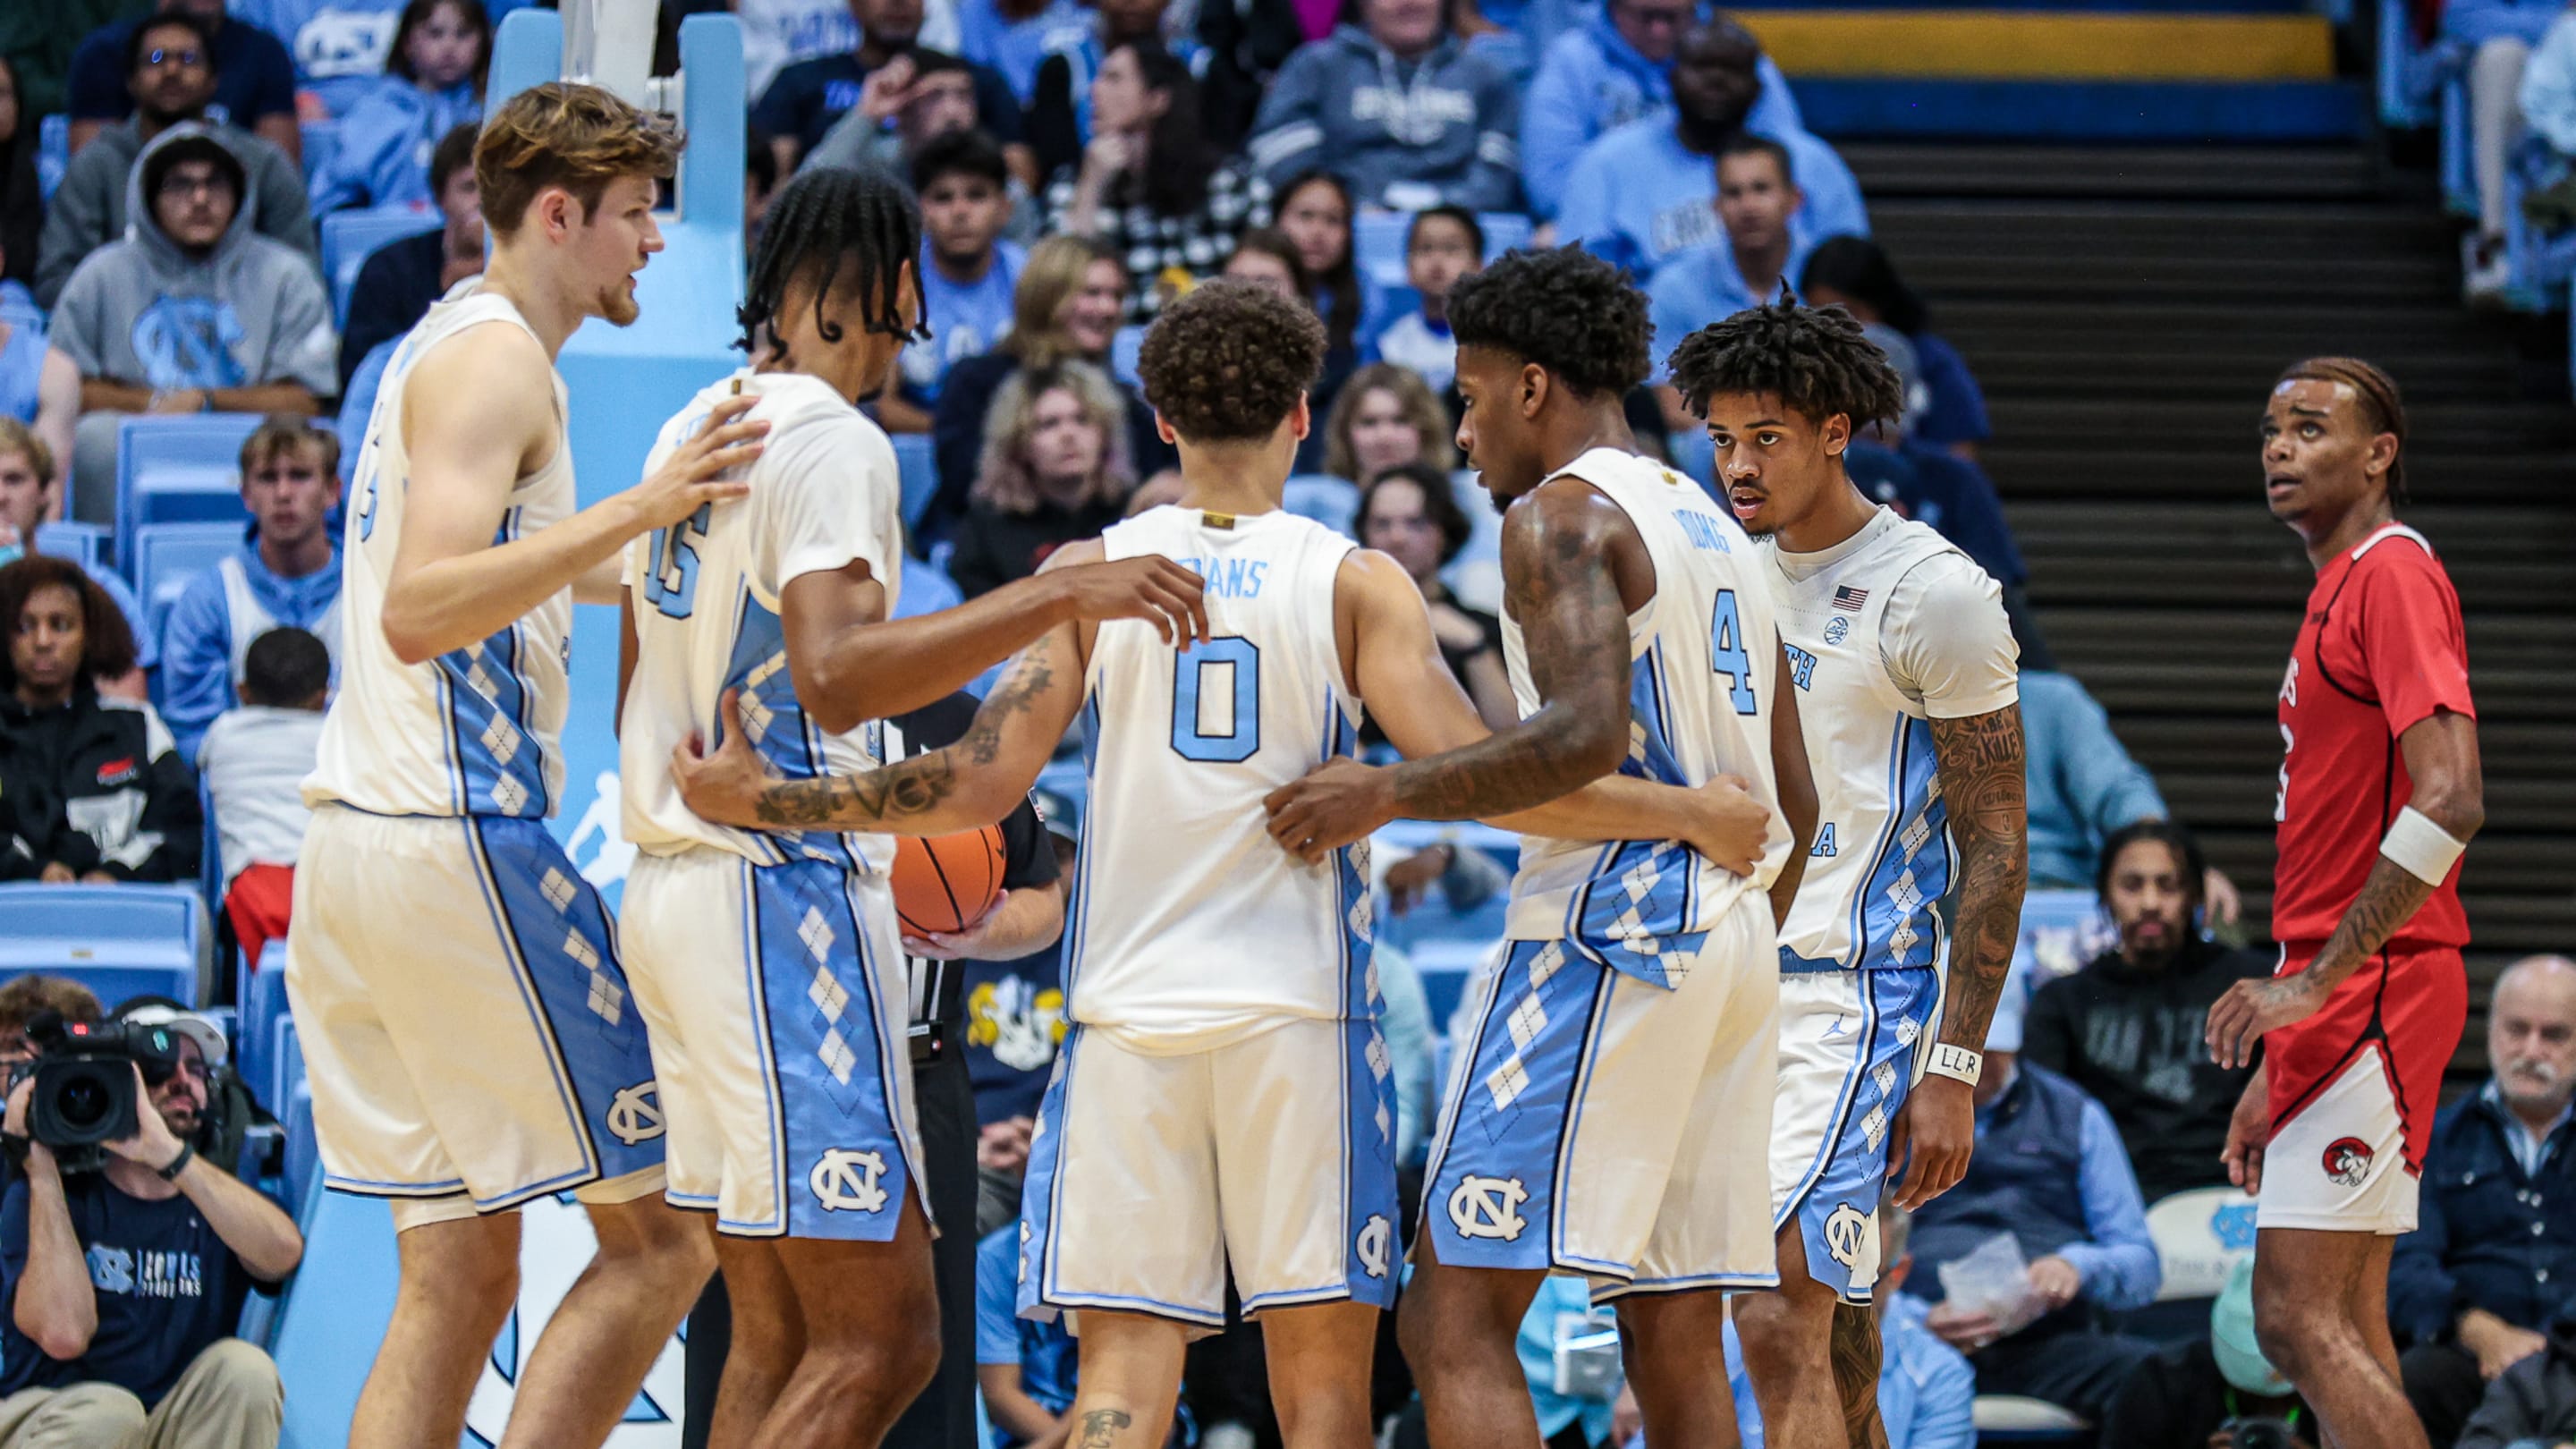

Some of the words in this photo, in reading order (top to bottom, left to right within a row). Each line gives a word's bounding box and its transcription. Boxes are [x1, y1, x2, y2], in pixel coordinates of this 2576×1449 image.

[1711, 588, 1758, 716] 4
[1170, 635, 1259, 763] 0
[1941, 1046, 1977, 1074] LLR
[808, 1146, 889, 1216] NC
[1446, 1173, 1531, 1243] NC
